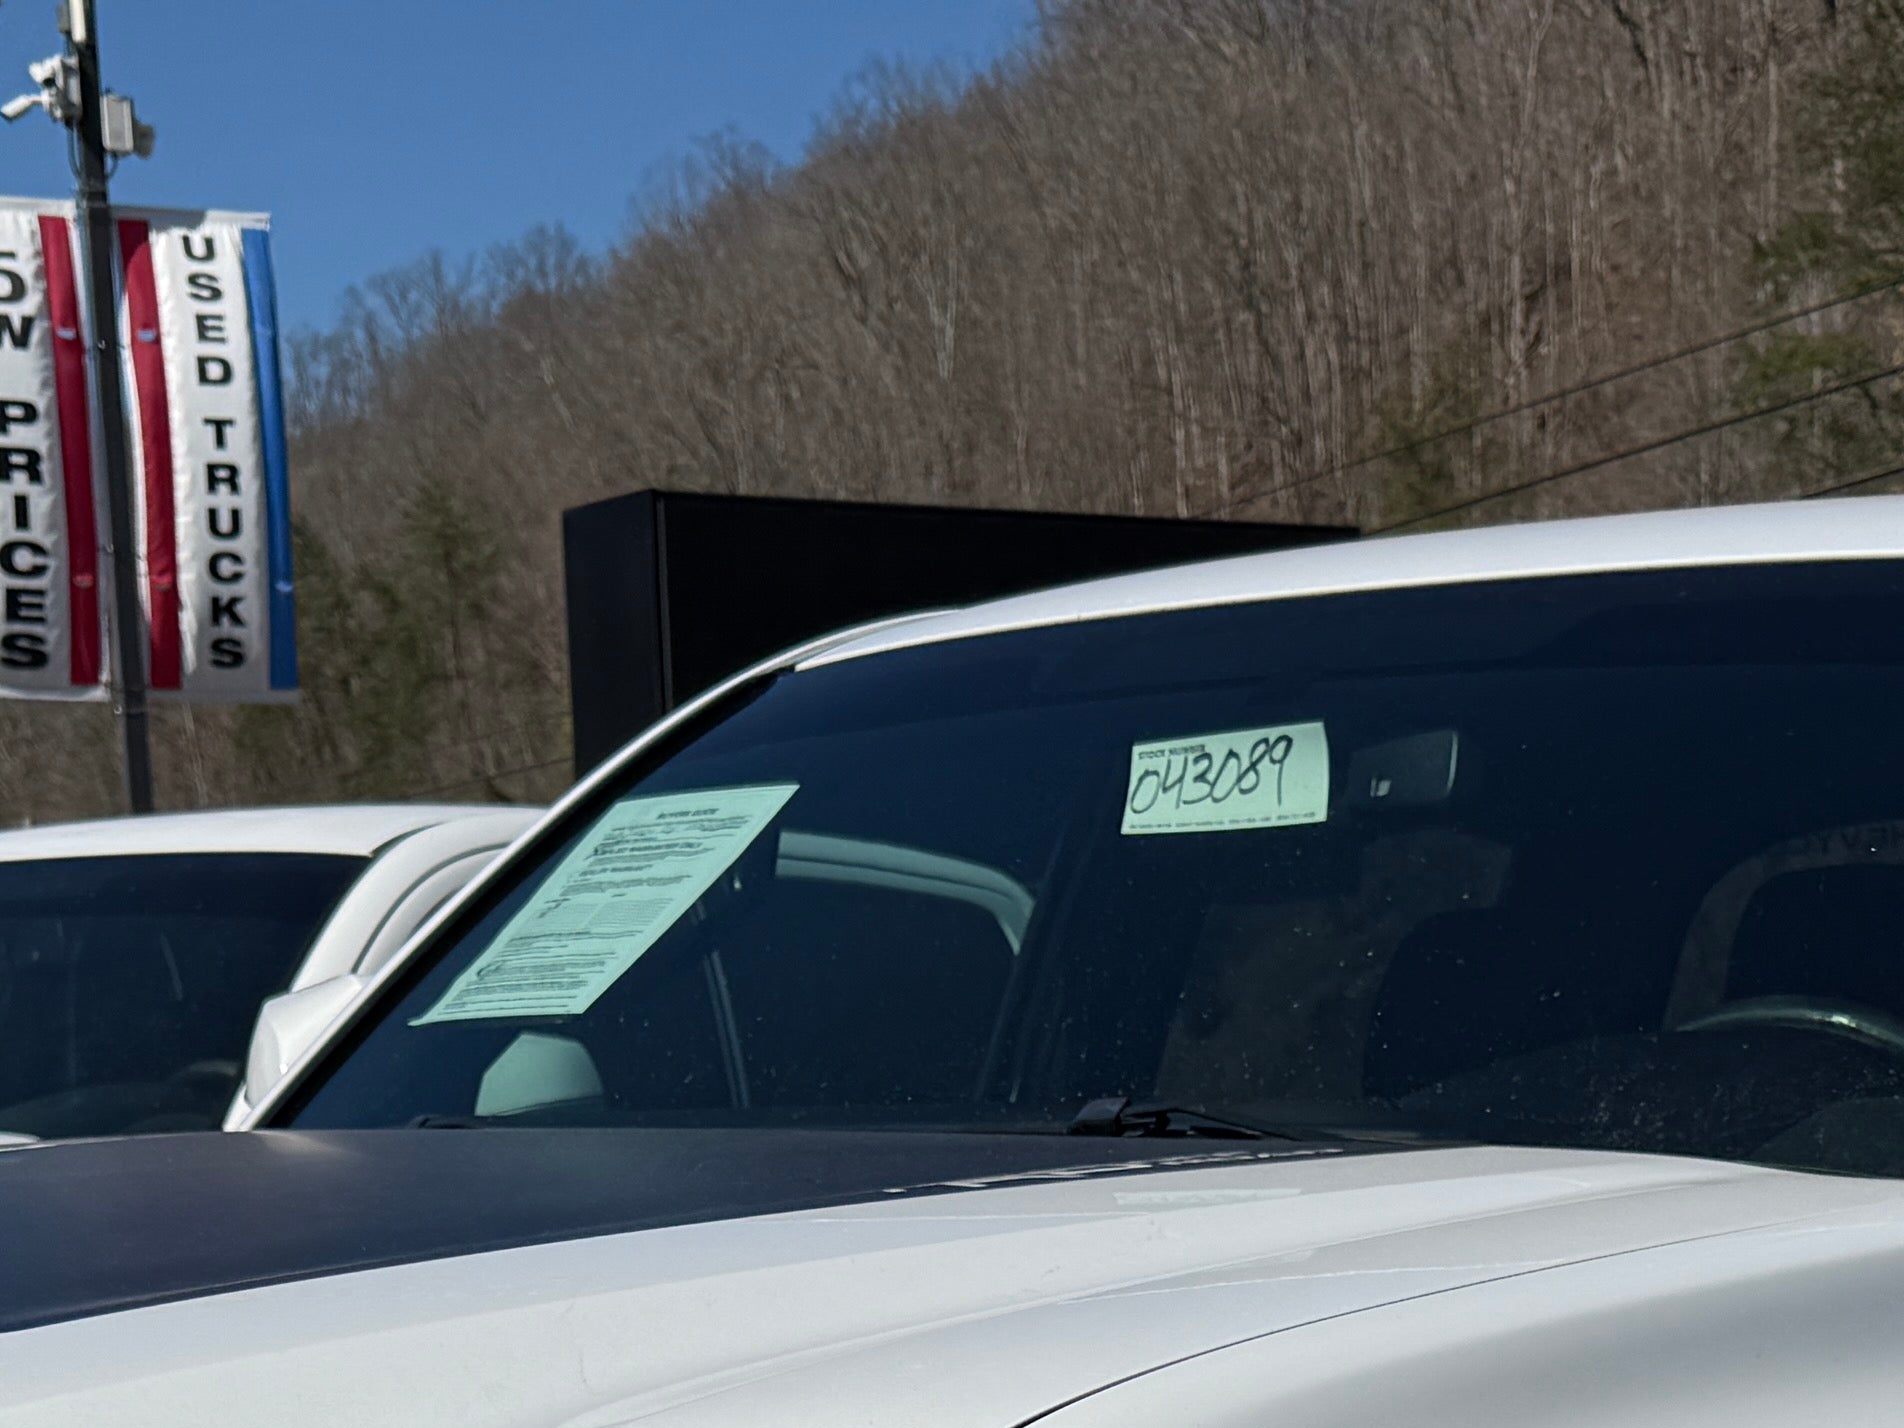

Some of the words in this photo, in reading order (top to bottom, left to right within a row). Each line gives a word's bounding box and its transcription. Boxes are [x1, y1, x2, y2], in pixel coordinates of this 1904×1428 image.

[181, 234, 233, 387] USED
[203, 418, 246, 669] TRUCKS
[1130, 734, 1294, 815] 043089
